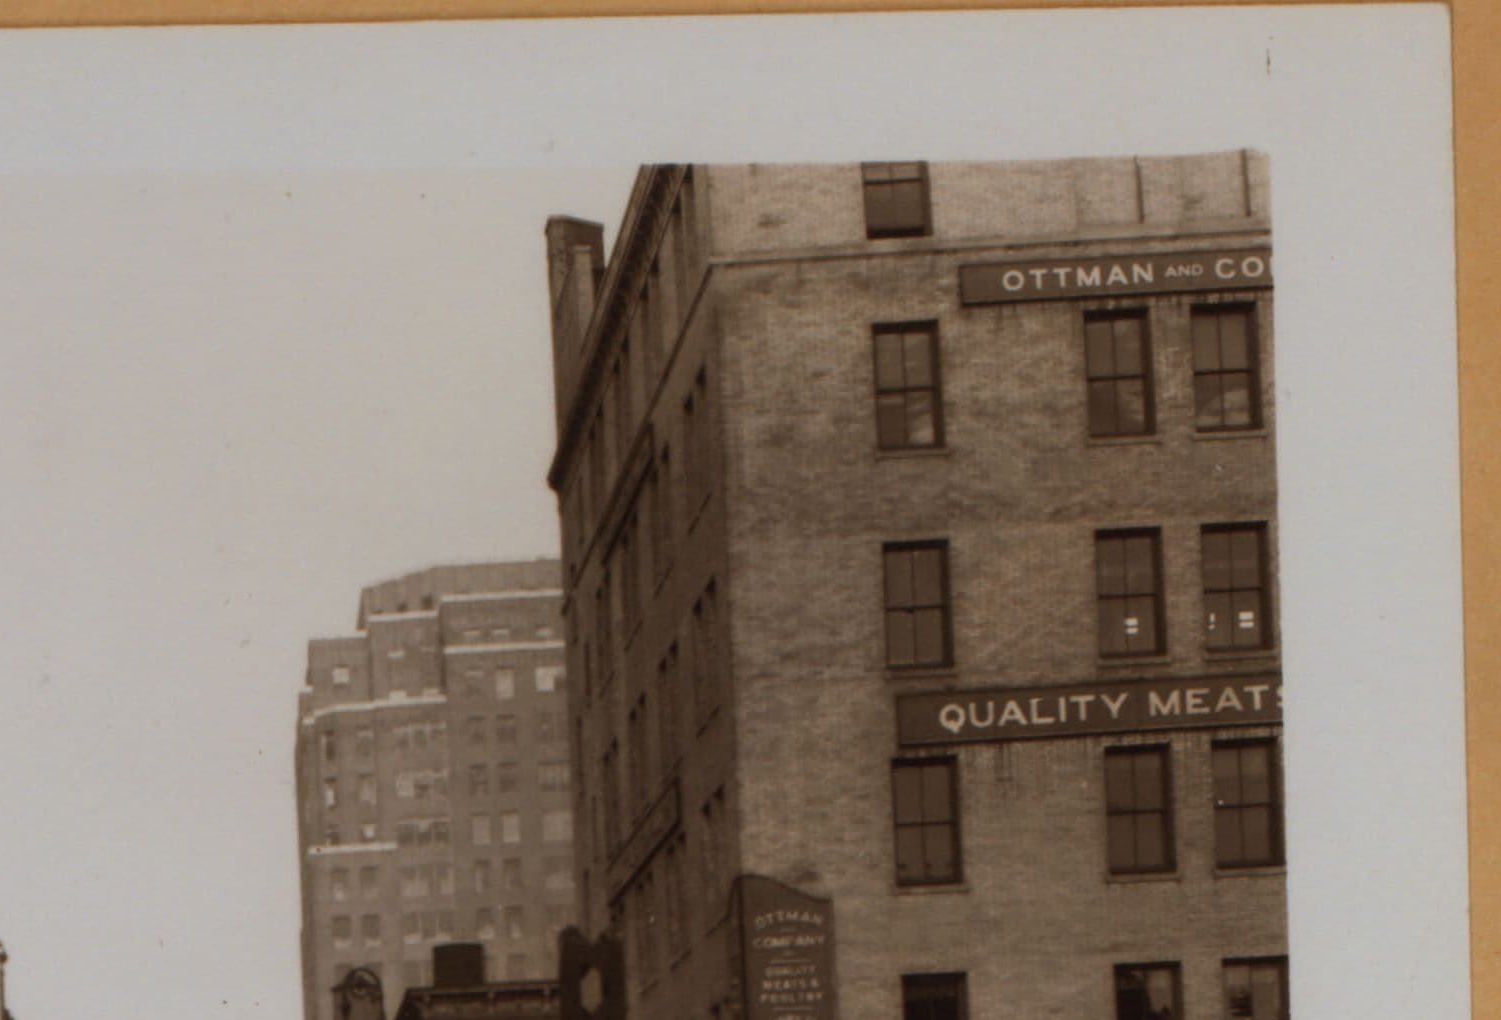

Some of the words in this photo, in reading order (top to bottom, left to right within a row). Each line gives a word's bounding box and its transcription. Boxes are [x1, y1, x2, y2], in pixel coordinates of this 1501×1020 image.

[1002, 262, 1154, 291] OTTMAN
[1164, 263, 1204, 278] AND
[1214, 255, 1273, 280] CO
[938, 692, 1129, 734] QUALITY
[754, 909, 824, 929] OTTMAN
[752, 934, 826, 948] COMPANY
